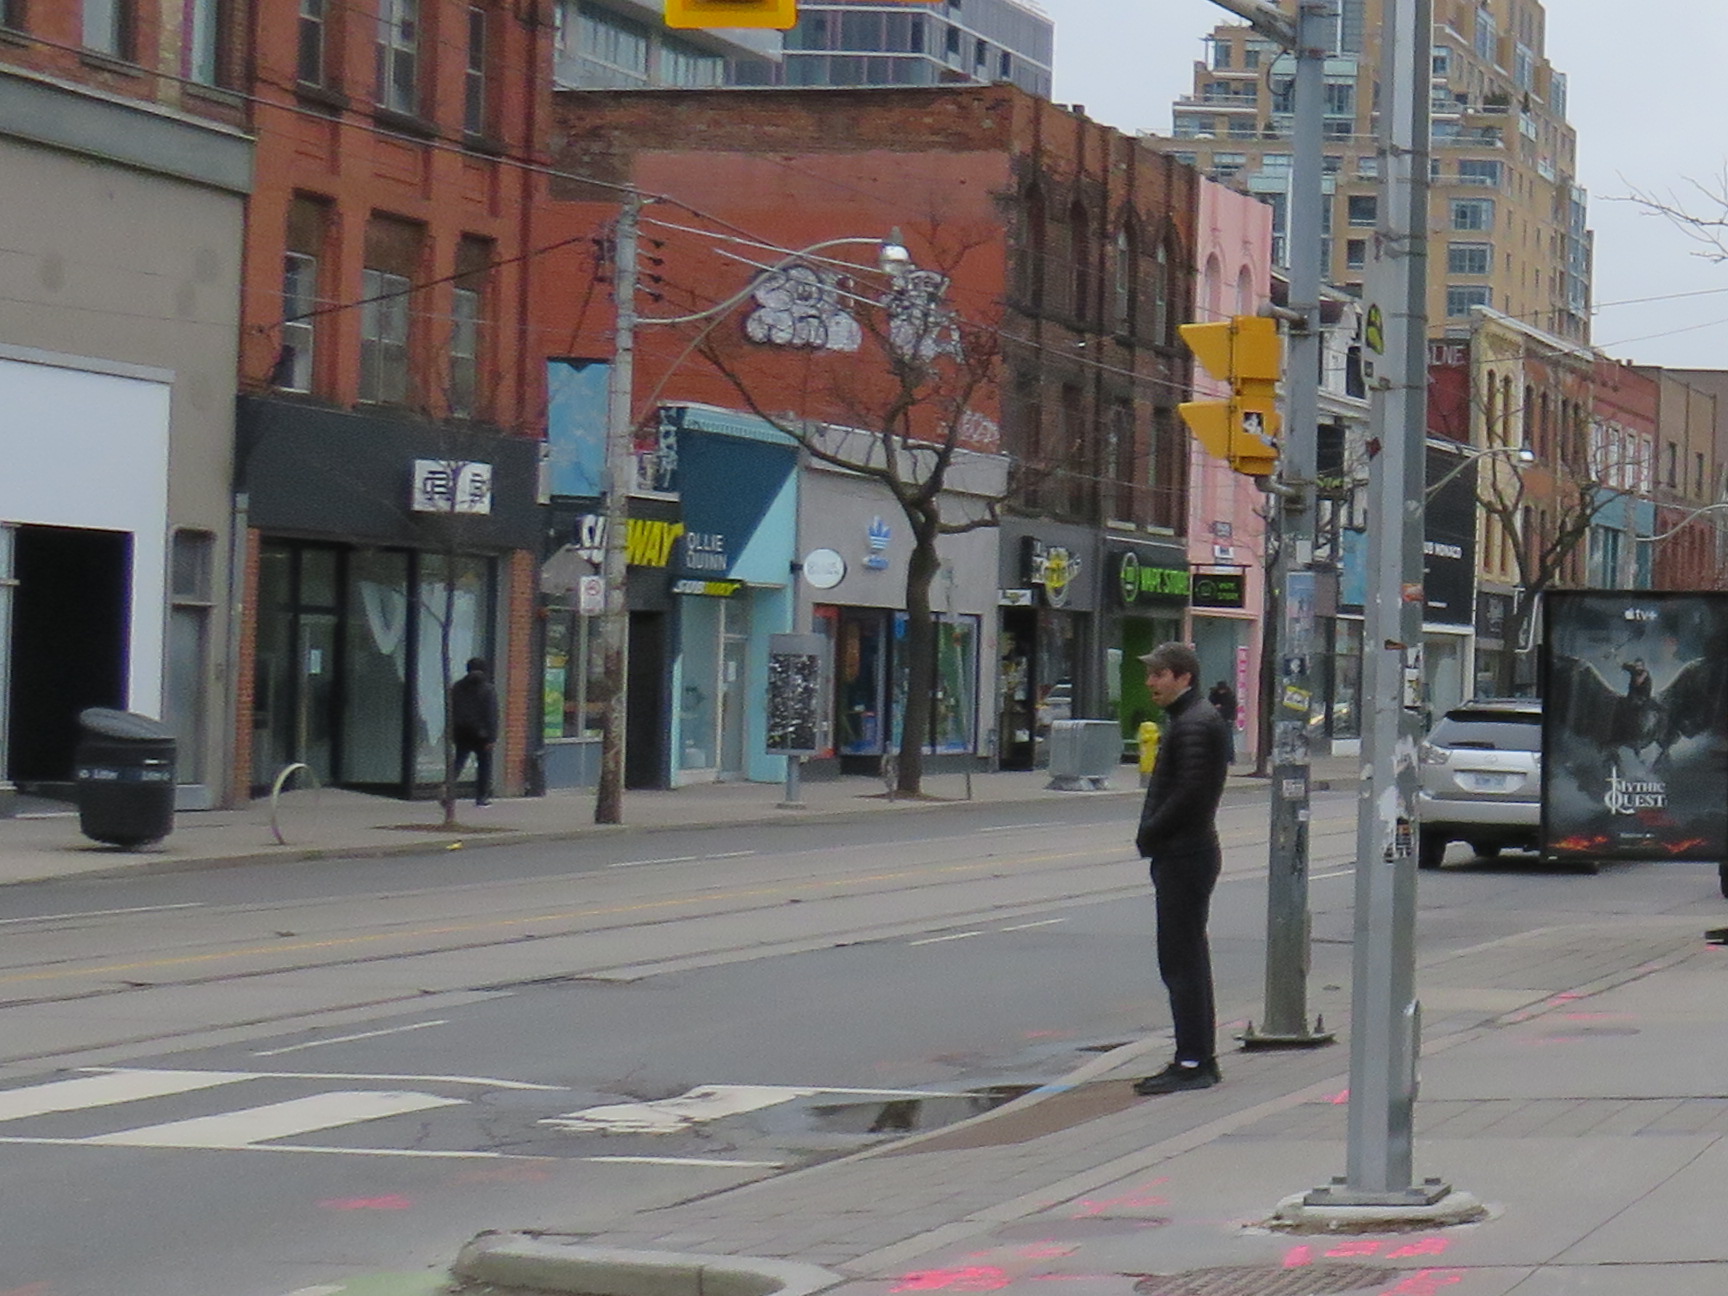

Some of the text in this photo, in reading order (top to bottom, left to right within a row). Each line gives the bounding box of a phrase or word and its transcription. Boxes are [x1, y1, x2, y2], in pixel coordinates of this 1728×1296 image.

[571, 514, 685, 567] SUWAY
[686, 552, 728, 571] QUINN
[673, 579, 744, 597] SUBWAY
[1611, 780, 1666, 793] MYTHIC
[1603, 790, 1665, 815] QUEST
